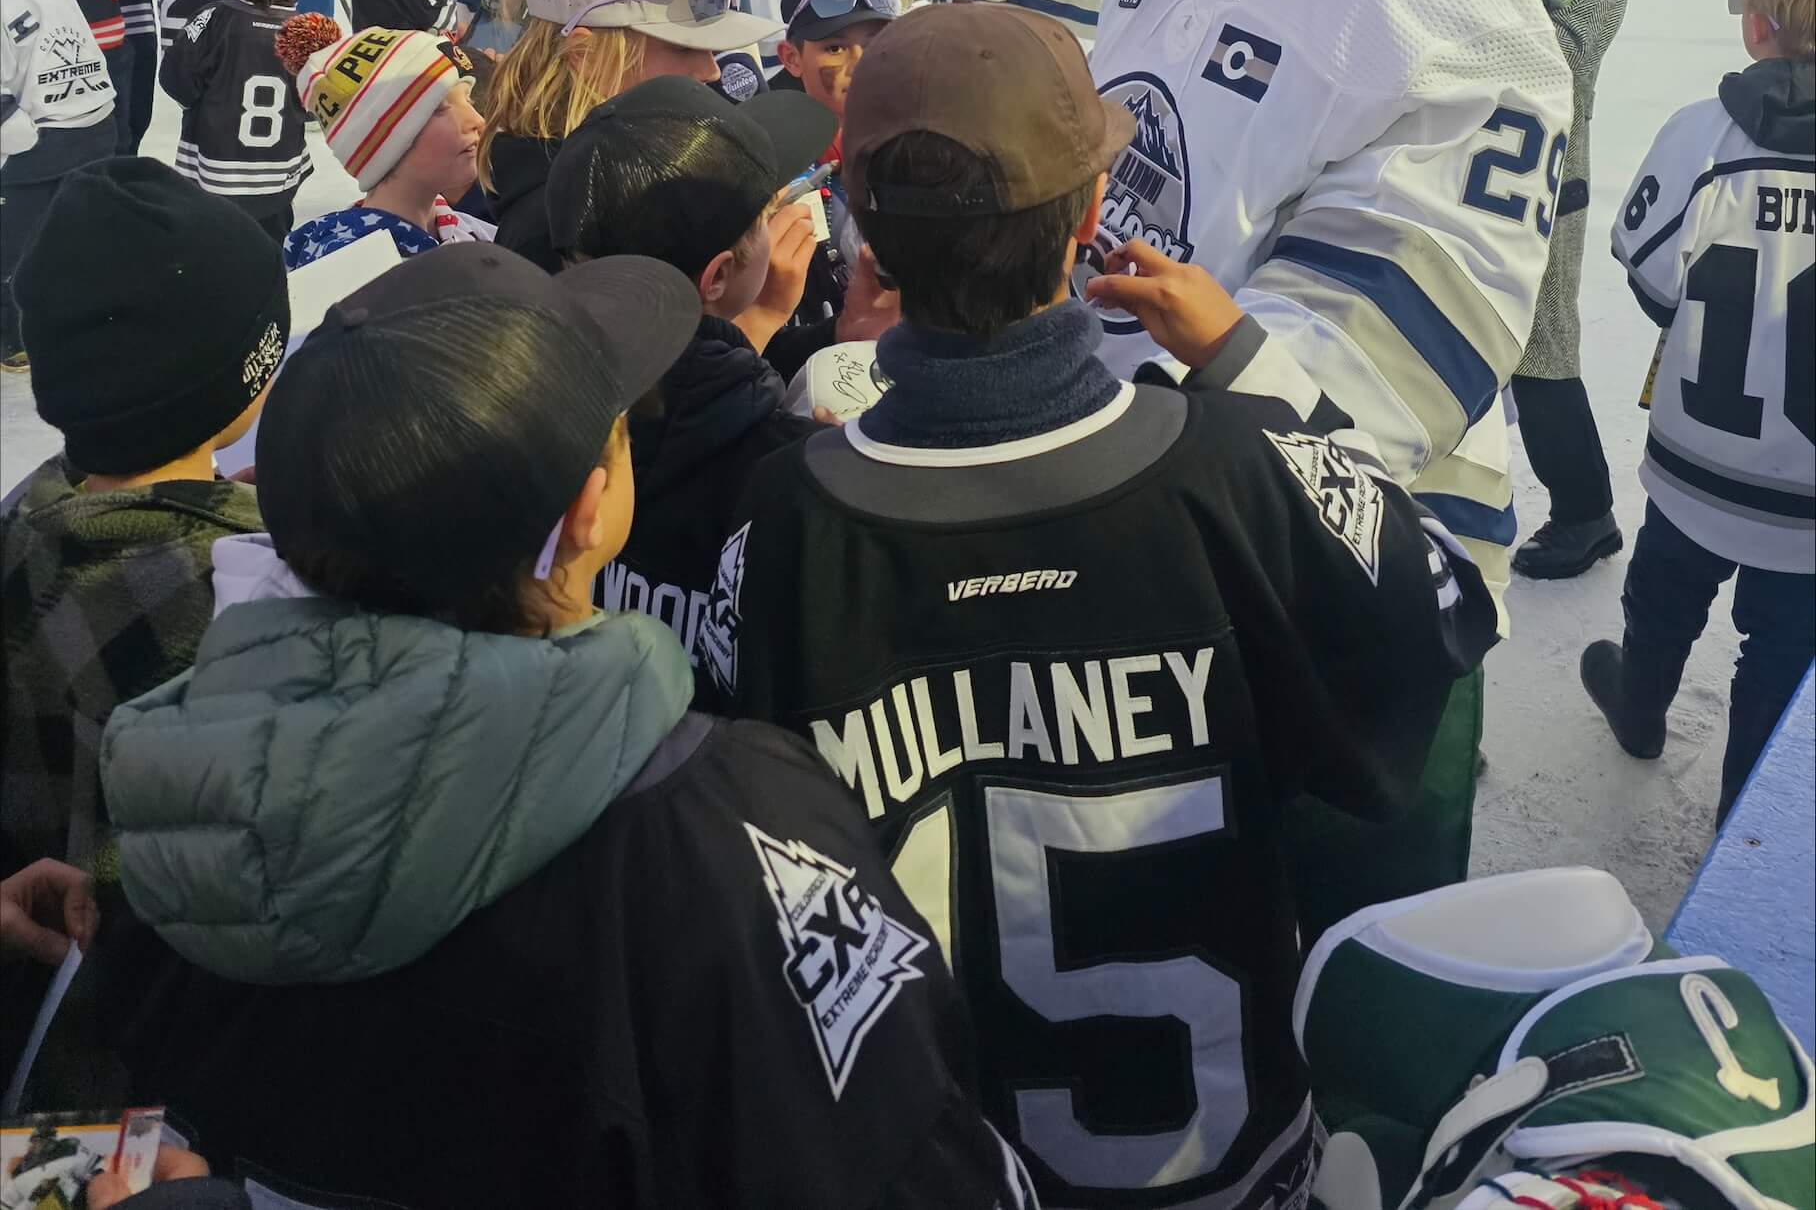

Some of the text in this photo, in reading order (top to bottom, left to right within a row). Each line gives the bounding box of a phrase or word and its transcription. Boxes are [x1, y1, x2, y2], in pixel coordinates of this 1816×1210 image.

[38, 61, 101, 85] EXTREME
[238, 75, 287, 147] 8
[947, 569, 1078, 601] VERBERO
[809, 646, 1214, 819] MULLANEY
[820, 965, 873, 1030] EXTREME
